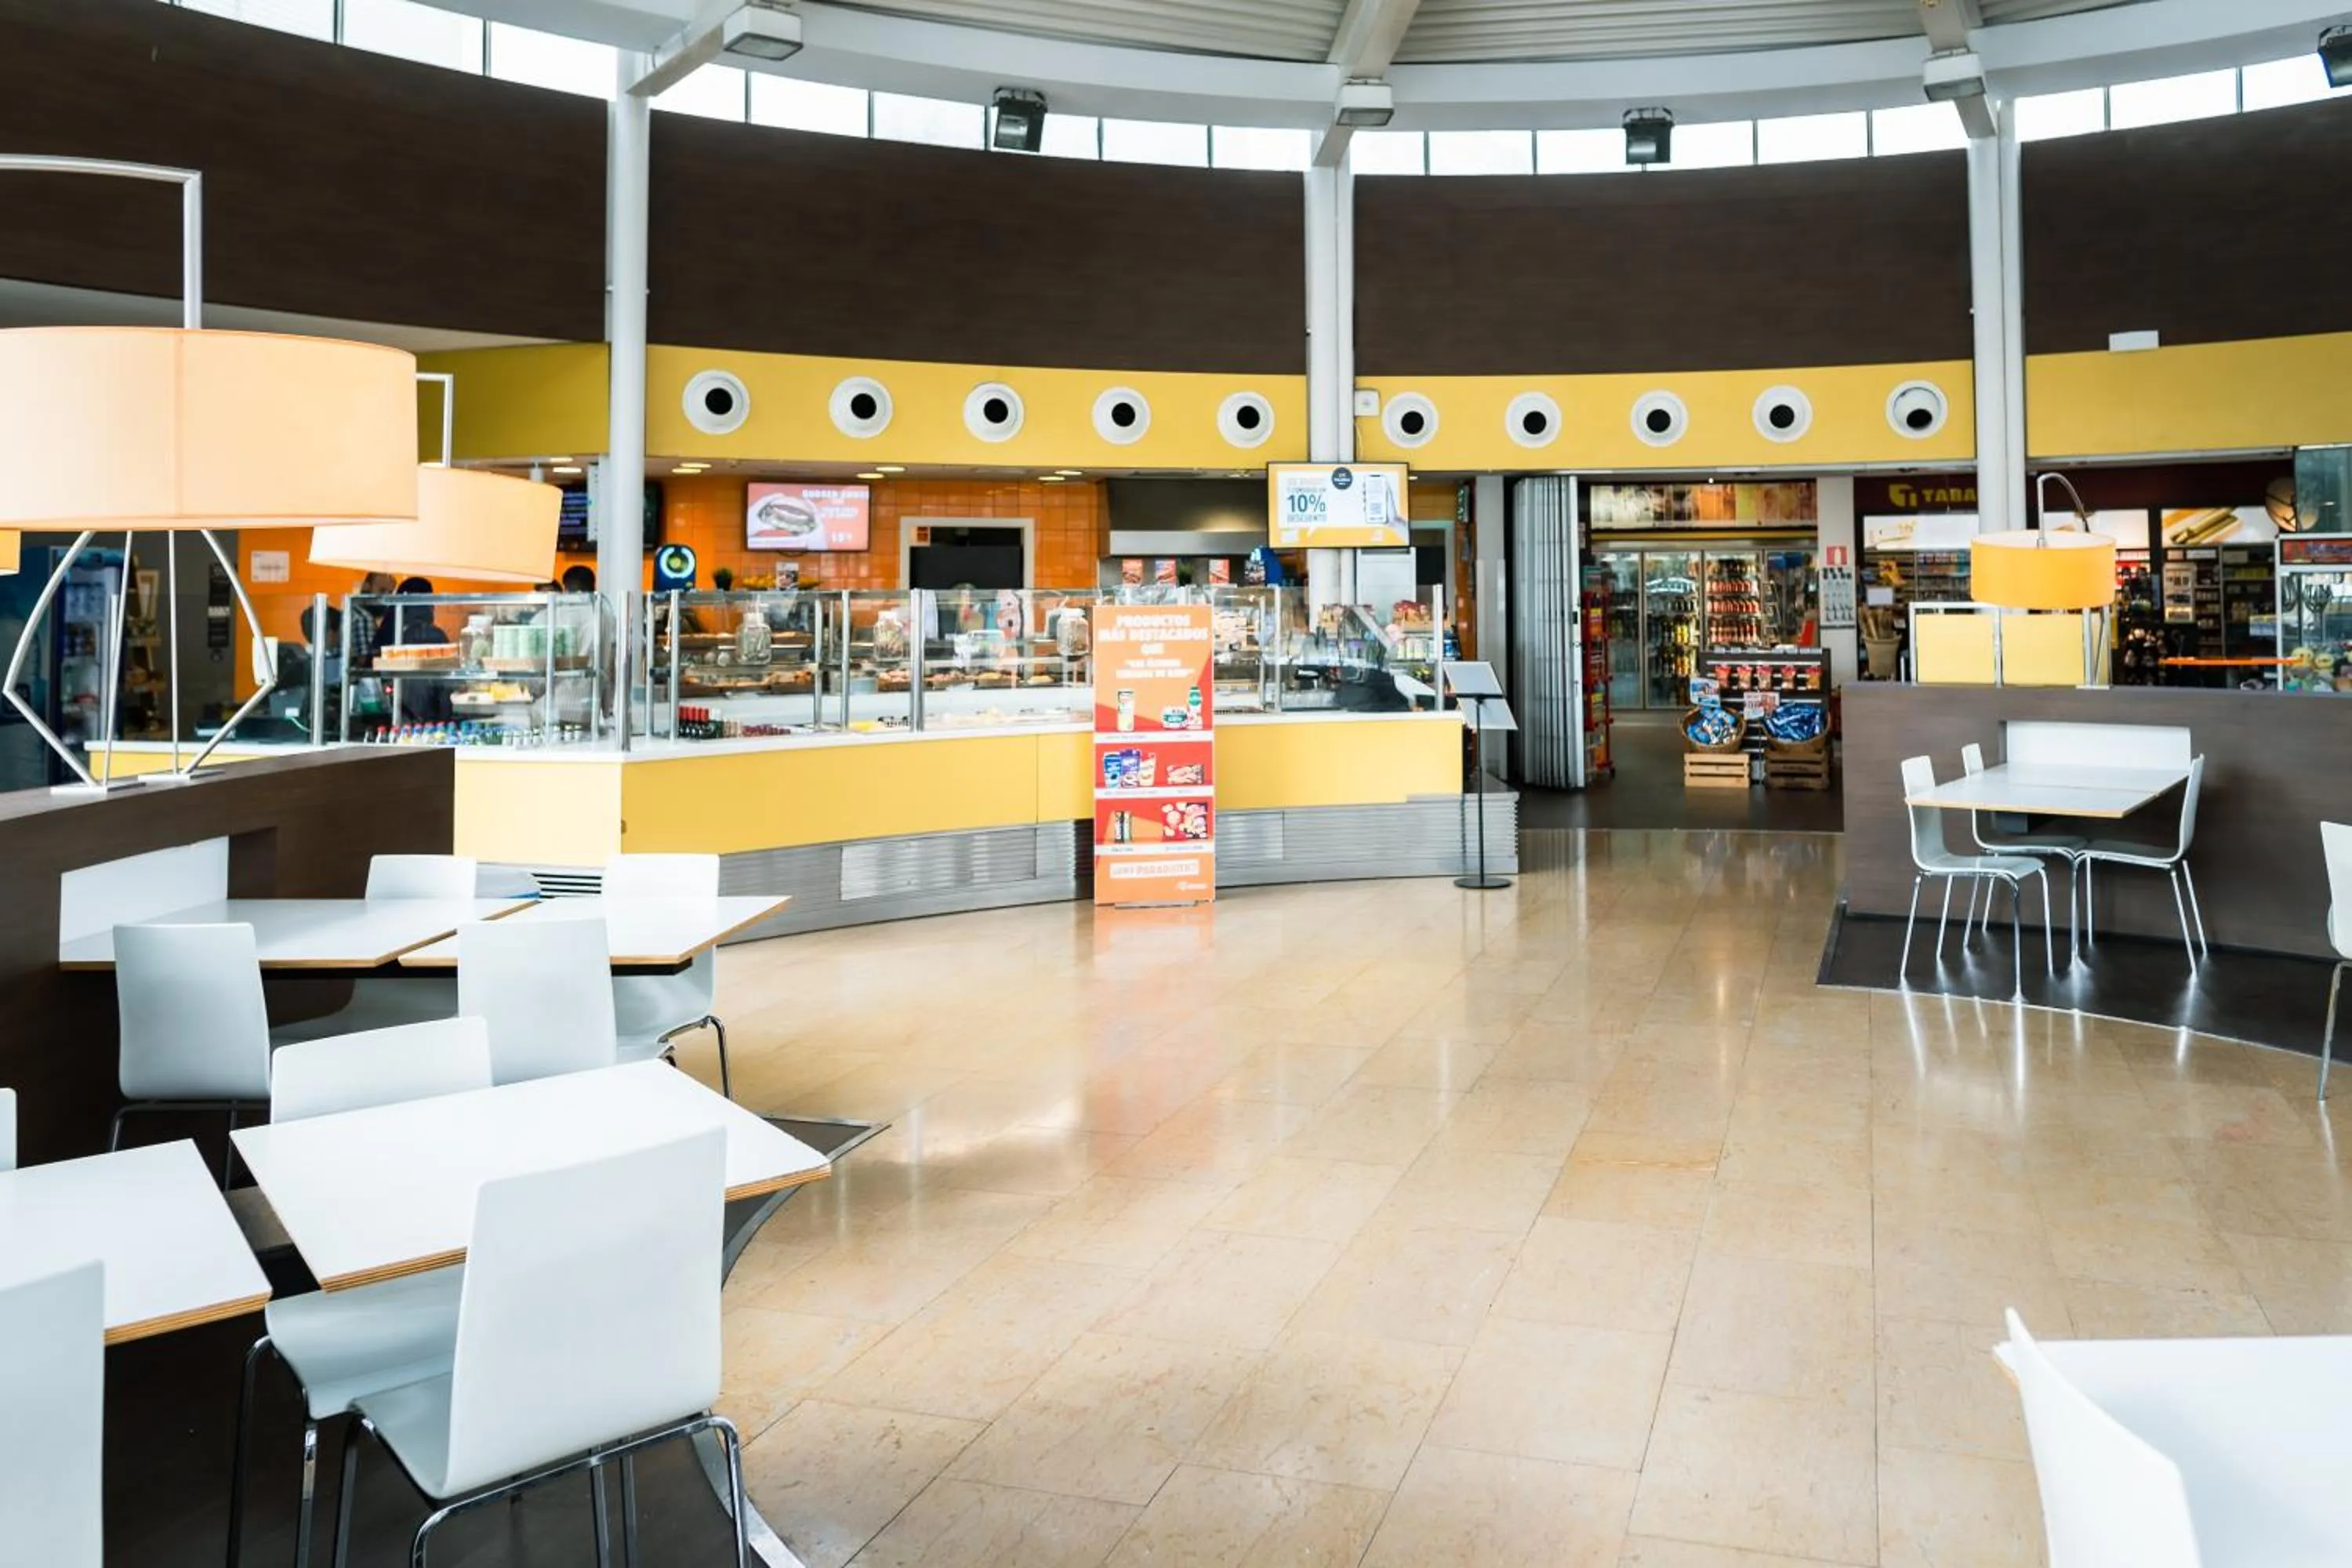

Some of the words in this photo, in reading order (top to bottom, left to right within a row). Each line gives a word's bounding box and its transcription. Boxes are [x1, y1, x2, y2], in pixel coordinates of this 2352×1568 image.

[1921, 488, 1976, 503] TABA
[1287, 494, 1326, 513] 10%
[1116, 615, 1191, 628] PRODUCTOS
[1128, 626, 1209, 641] DESTACADOS
